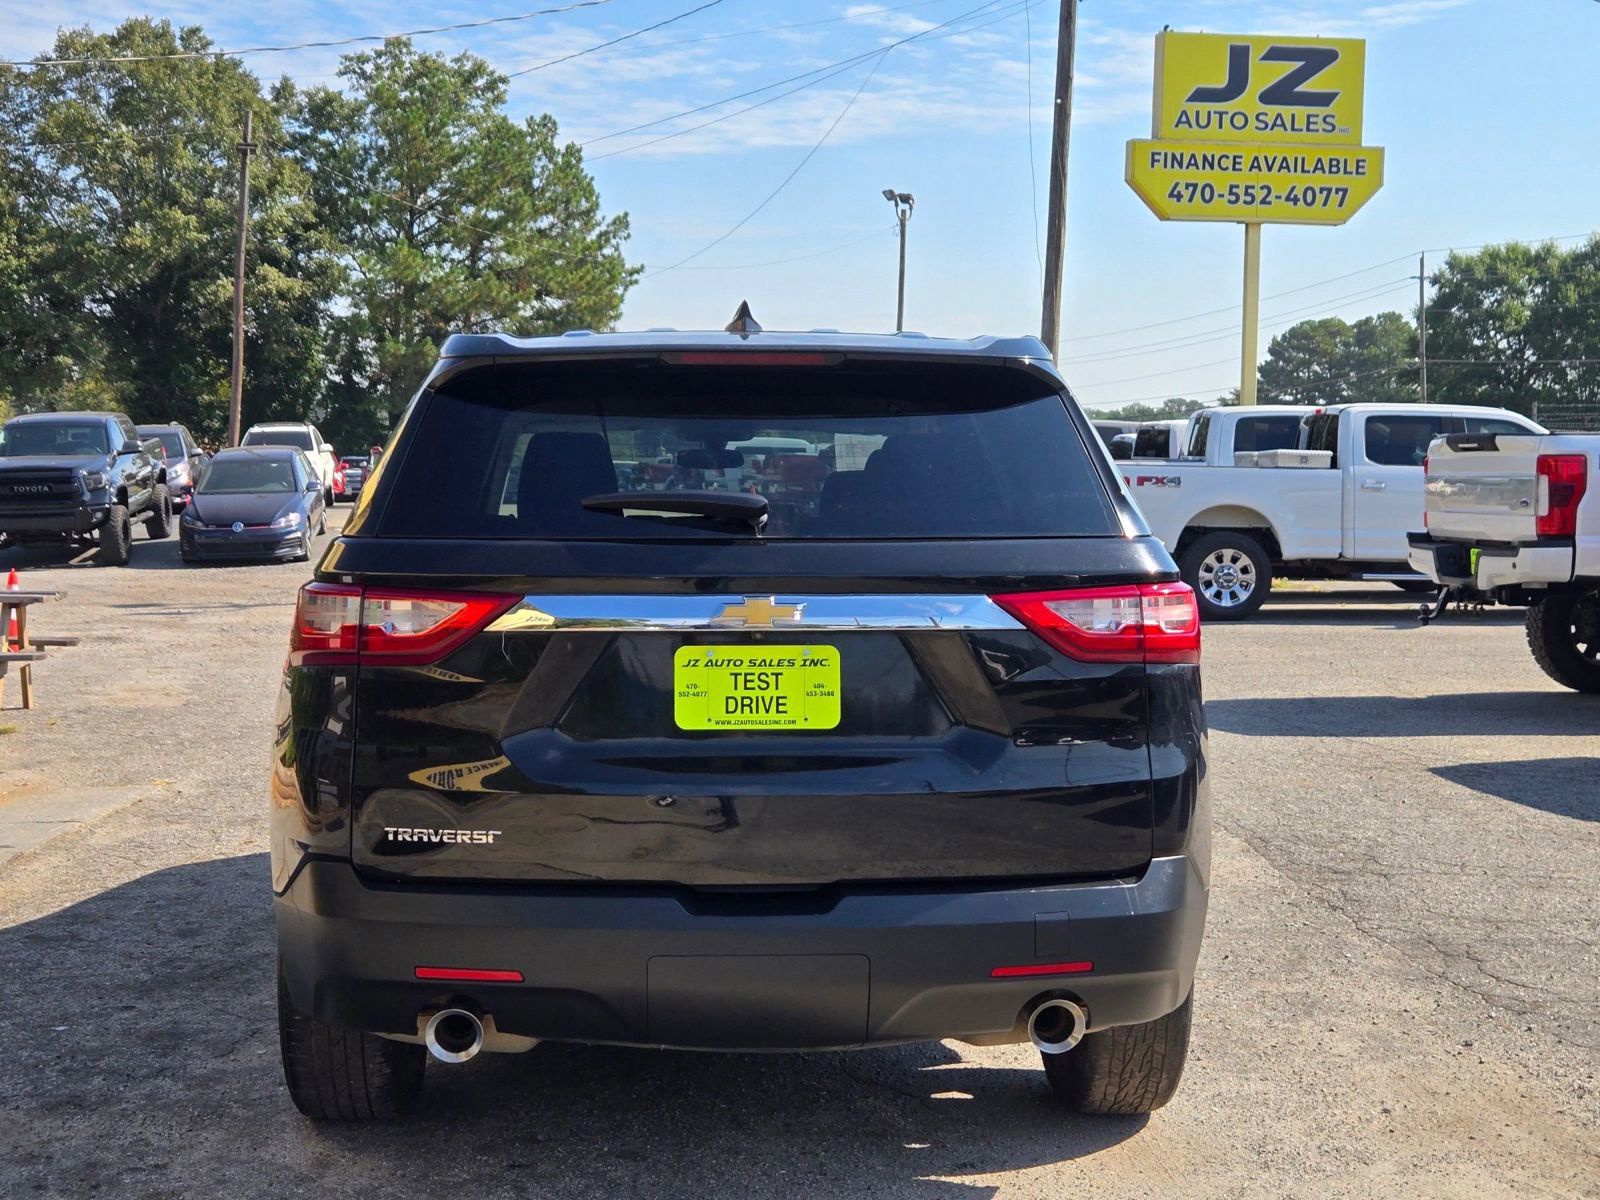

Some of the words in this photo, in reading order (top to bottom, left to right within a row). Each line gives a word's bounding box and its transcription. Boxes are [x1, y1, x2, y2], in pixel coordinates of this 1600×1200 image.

[1184, 43, 1341, 107] JZ
[1174, 109, 1249, 131] AUTO
[1254, 111, 1337, 133] SALES
[1150, 151, 1244, 172] FINANCE
[1248, 155, 1367, 176] AVAILABLE
[1168, 181, 1349, 208] 470-552-4077
[13, 485, 49, 493] TOYOTA
[1136, 475, 1182, 488] FX4
[682, 658, 702, 668] JZ
[704, 658, 744, 668] AUTO
[747, 658, 797, 668] SALES
[800, 658, 831, 668] INC.
[729, 672, 784, 691] TEST
[725, 695, 788, 714] DRIVE
